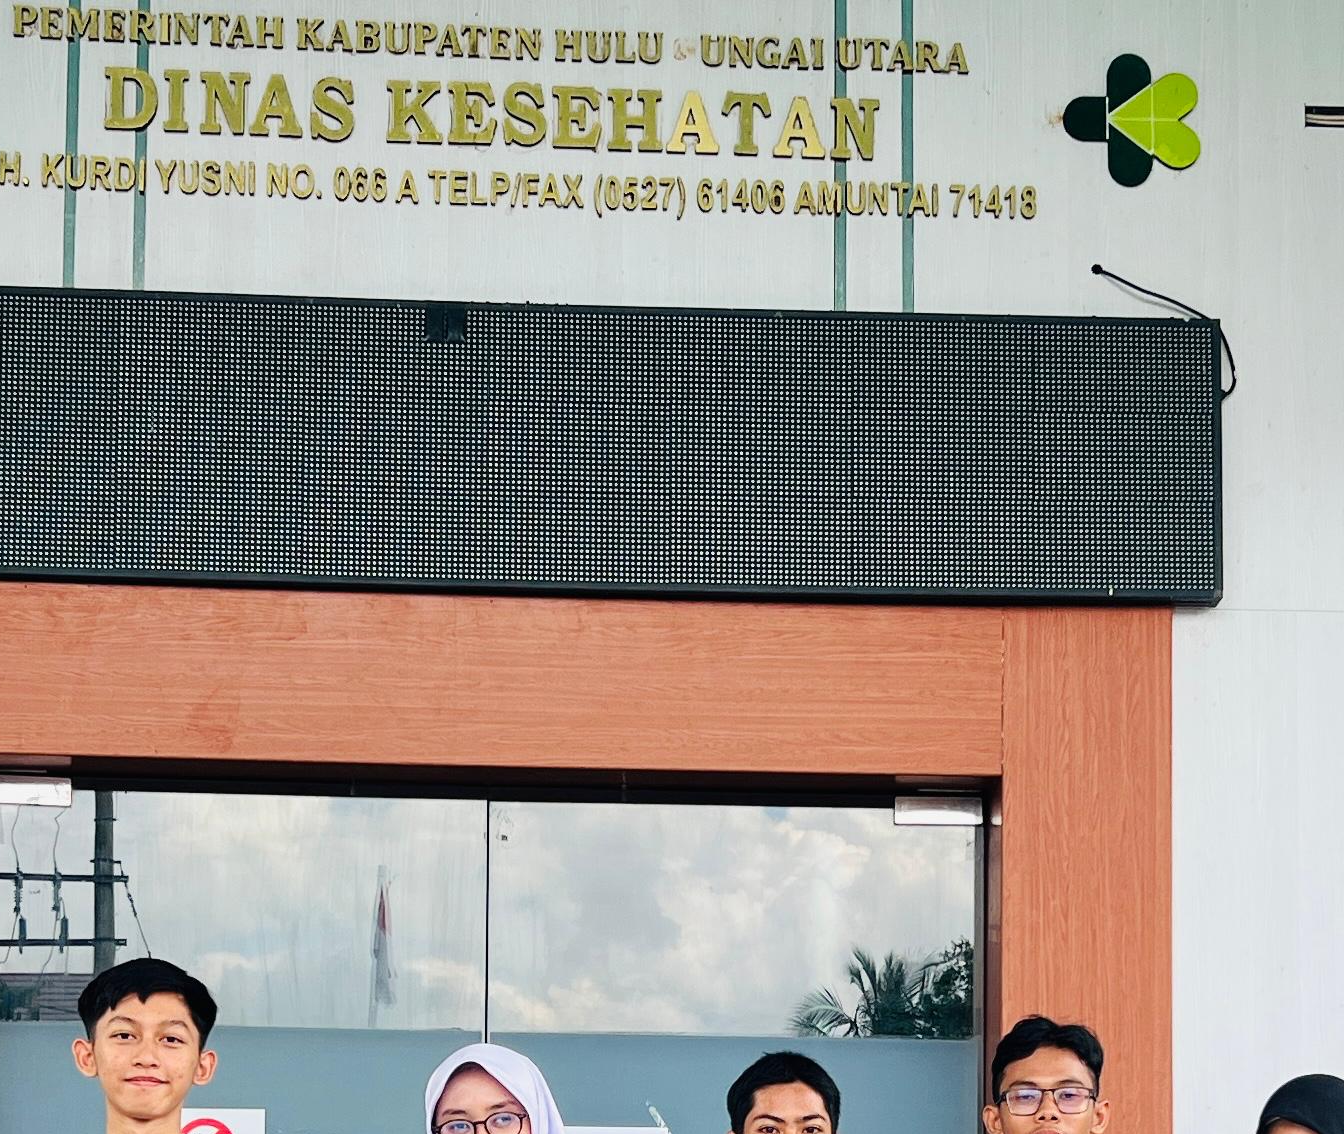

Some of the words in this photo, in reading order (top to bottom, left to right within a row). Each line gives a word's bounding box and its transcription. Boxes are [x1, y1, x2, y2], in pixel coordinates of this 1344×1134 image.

[13, 4, 285, 50] PEMERINTAH
[296, 17, 542, 61] KABUPATEN
[554, 28, 664, 64] HULU
[837, 37, 970, 75] UTARA
[104, 66, 355, 143] DINAS
[386, 78, 881, 162] KESEHATAN
[40, 152, 147, 195] KURDI
[155, 160, 256, 197] YUSNI
[266, 162, 323, 199] NO.
[333, 166, 388, 203] 066
[395, 169, 419, 205] A
[428, 169, 585, 208] TELP/FAX
[593, 173, 687, 221] (0527)
[696, 178, 786, 214] 61406
[793, 180, 940, 217] AMUNTAI
[949, 184, 1038, 220] 71418
